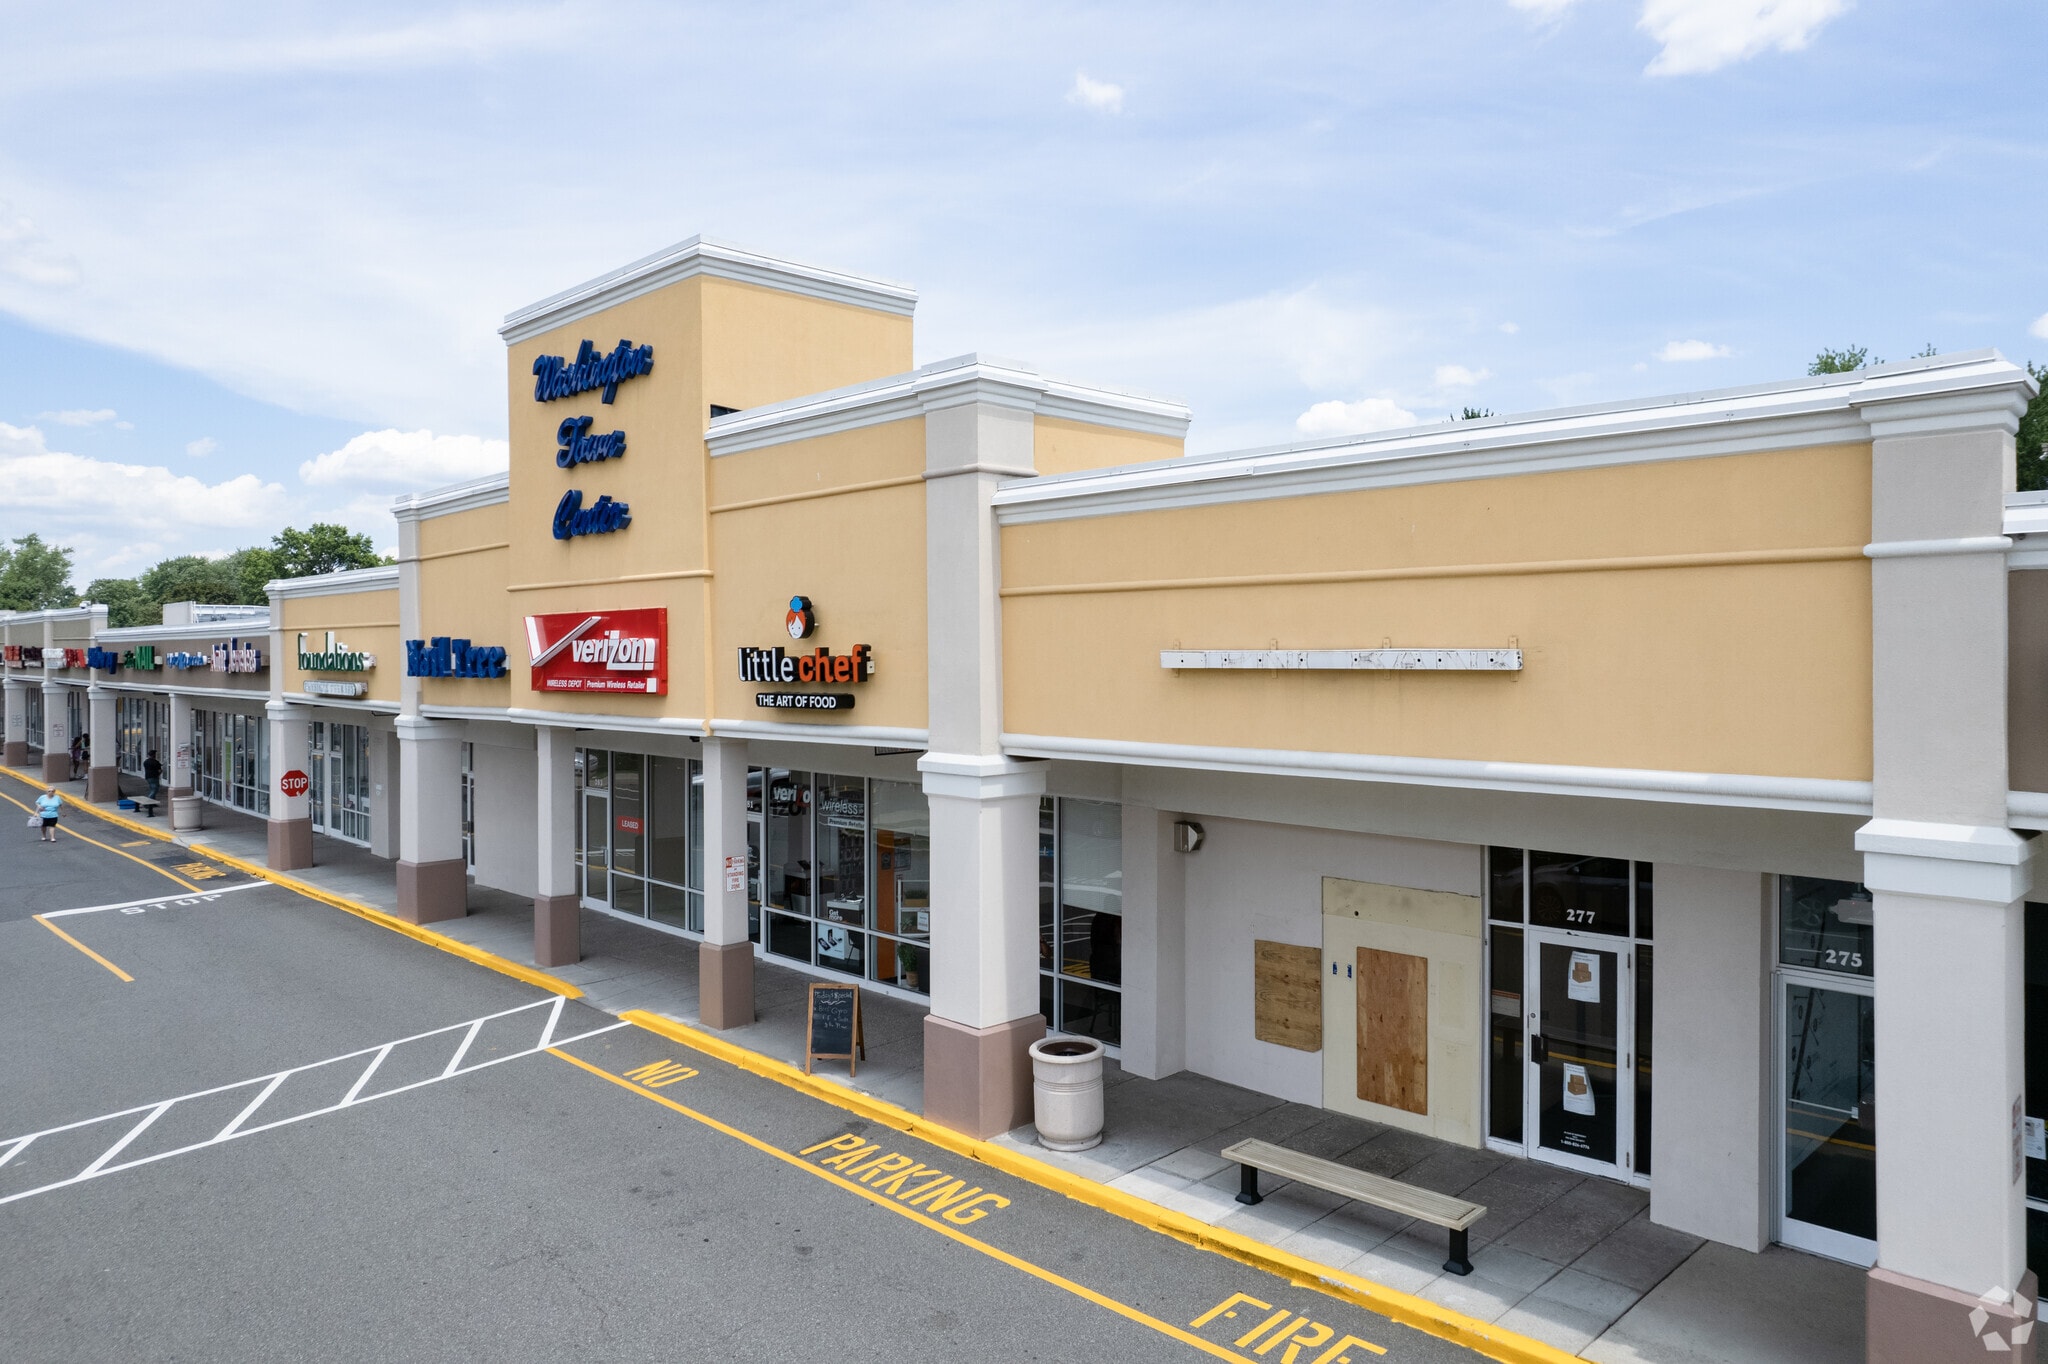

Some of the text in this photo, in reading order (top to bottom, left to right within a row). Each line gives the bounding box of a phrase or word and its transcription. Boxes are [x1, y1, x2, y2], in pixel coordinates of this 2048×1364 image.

[533, 339, 654, 405] Washington
[556, 415, 626, 468] Town
[552, 489, 632, 540] Center
[572, 630, 655, 671] verizon
[738, 644, 867, 684] little chef
[546, 679, 568, 688] WIRELESS
[586, 680, 605, 689] Premium
[606, 681, 626, 689] Wireless
[627, 681, 646, 689] Retailer
[757, 694, 837, 709] THE ART OF FOOD
[282, 777, 308, 790] STOP
[1566, 908, 1596, 925] 277
[1825, 949, 1863, 968] 275
[622, 1059, 1388, 1364] NO PARKING FIRE
